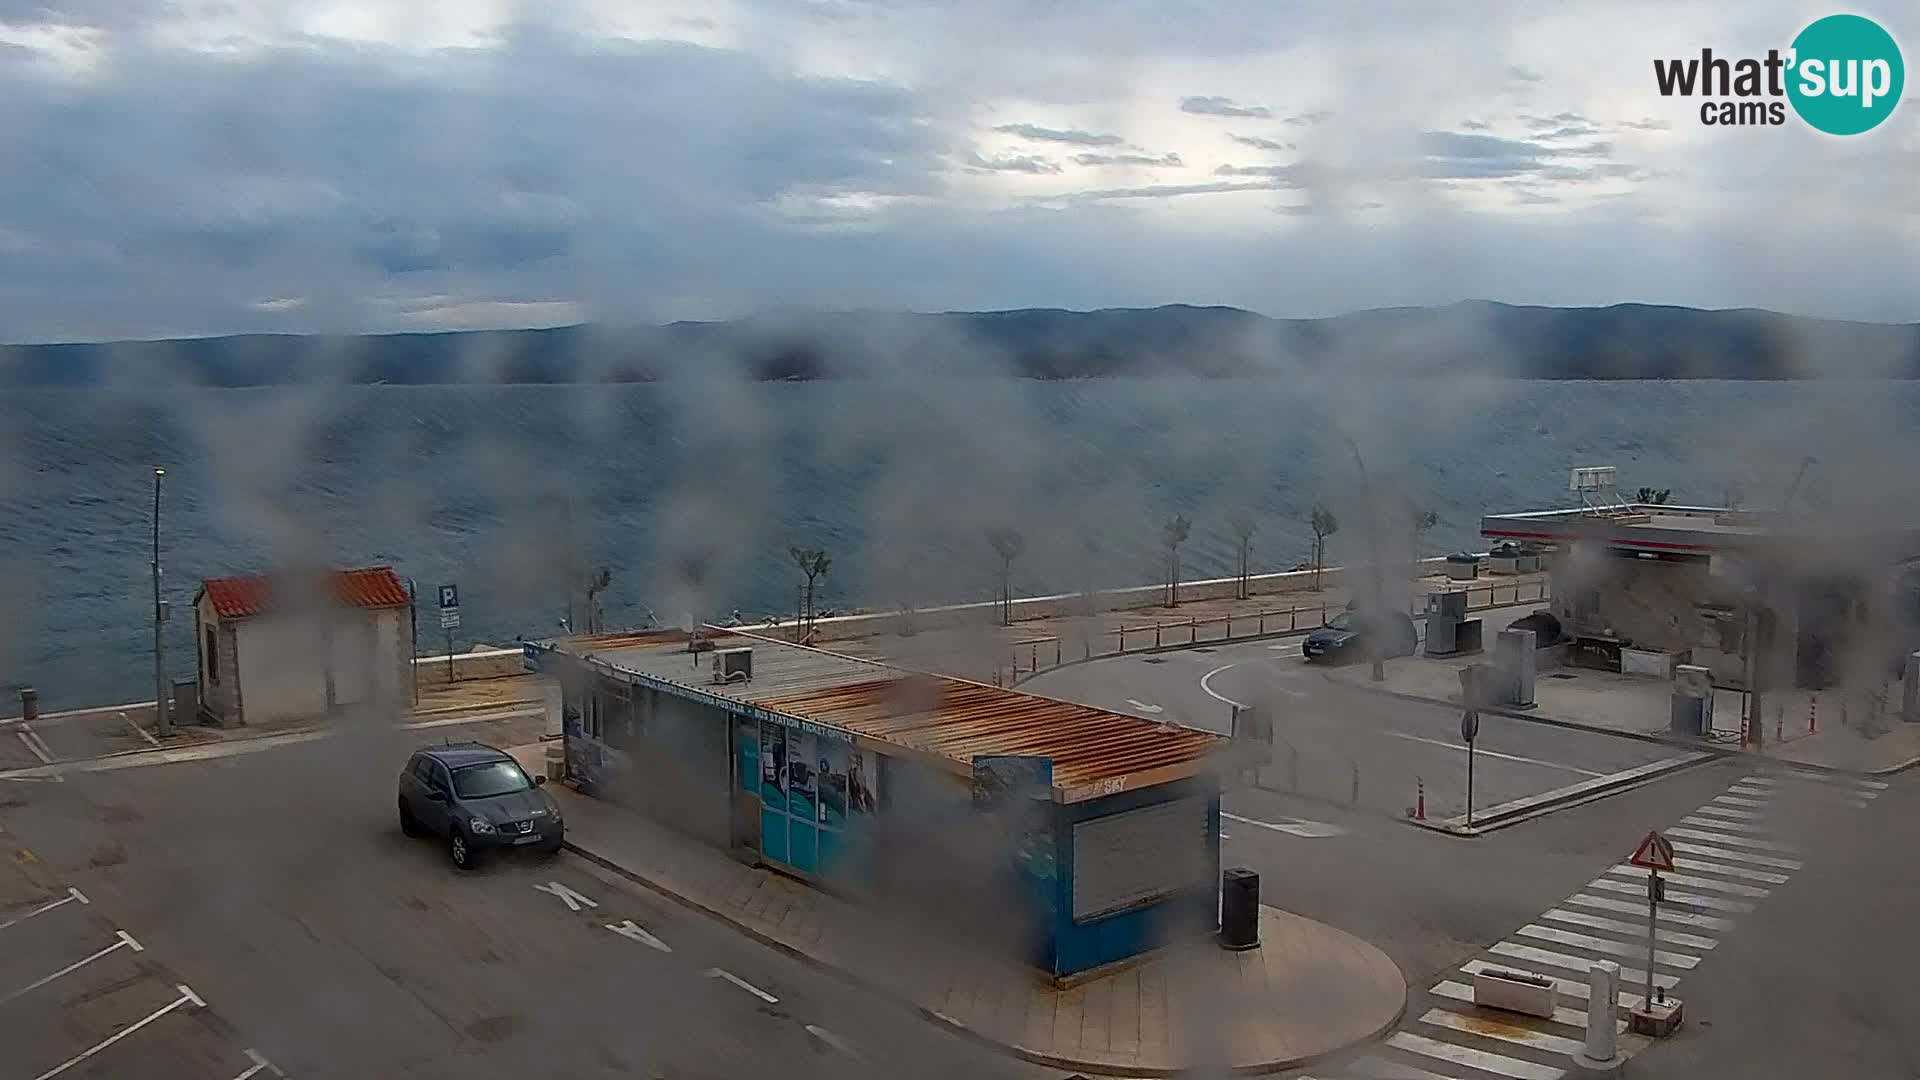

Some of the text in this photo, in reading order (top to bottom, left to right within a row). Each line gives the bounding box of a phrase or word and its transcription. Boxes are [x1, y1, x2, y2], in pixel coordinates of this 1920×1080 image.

[715, 698, 745, 714] POSTAJA
[754, 708, 769, 720] BUS
[769, 711, 800, 729] STATION
[801, 720, 826, 737] TICKET
[827, 725, 853, 743] OFFICE
